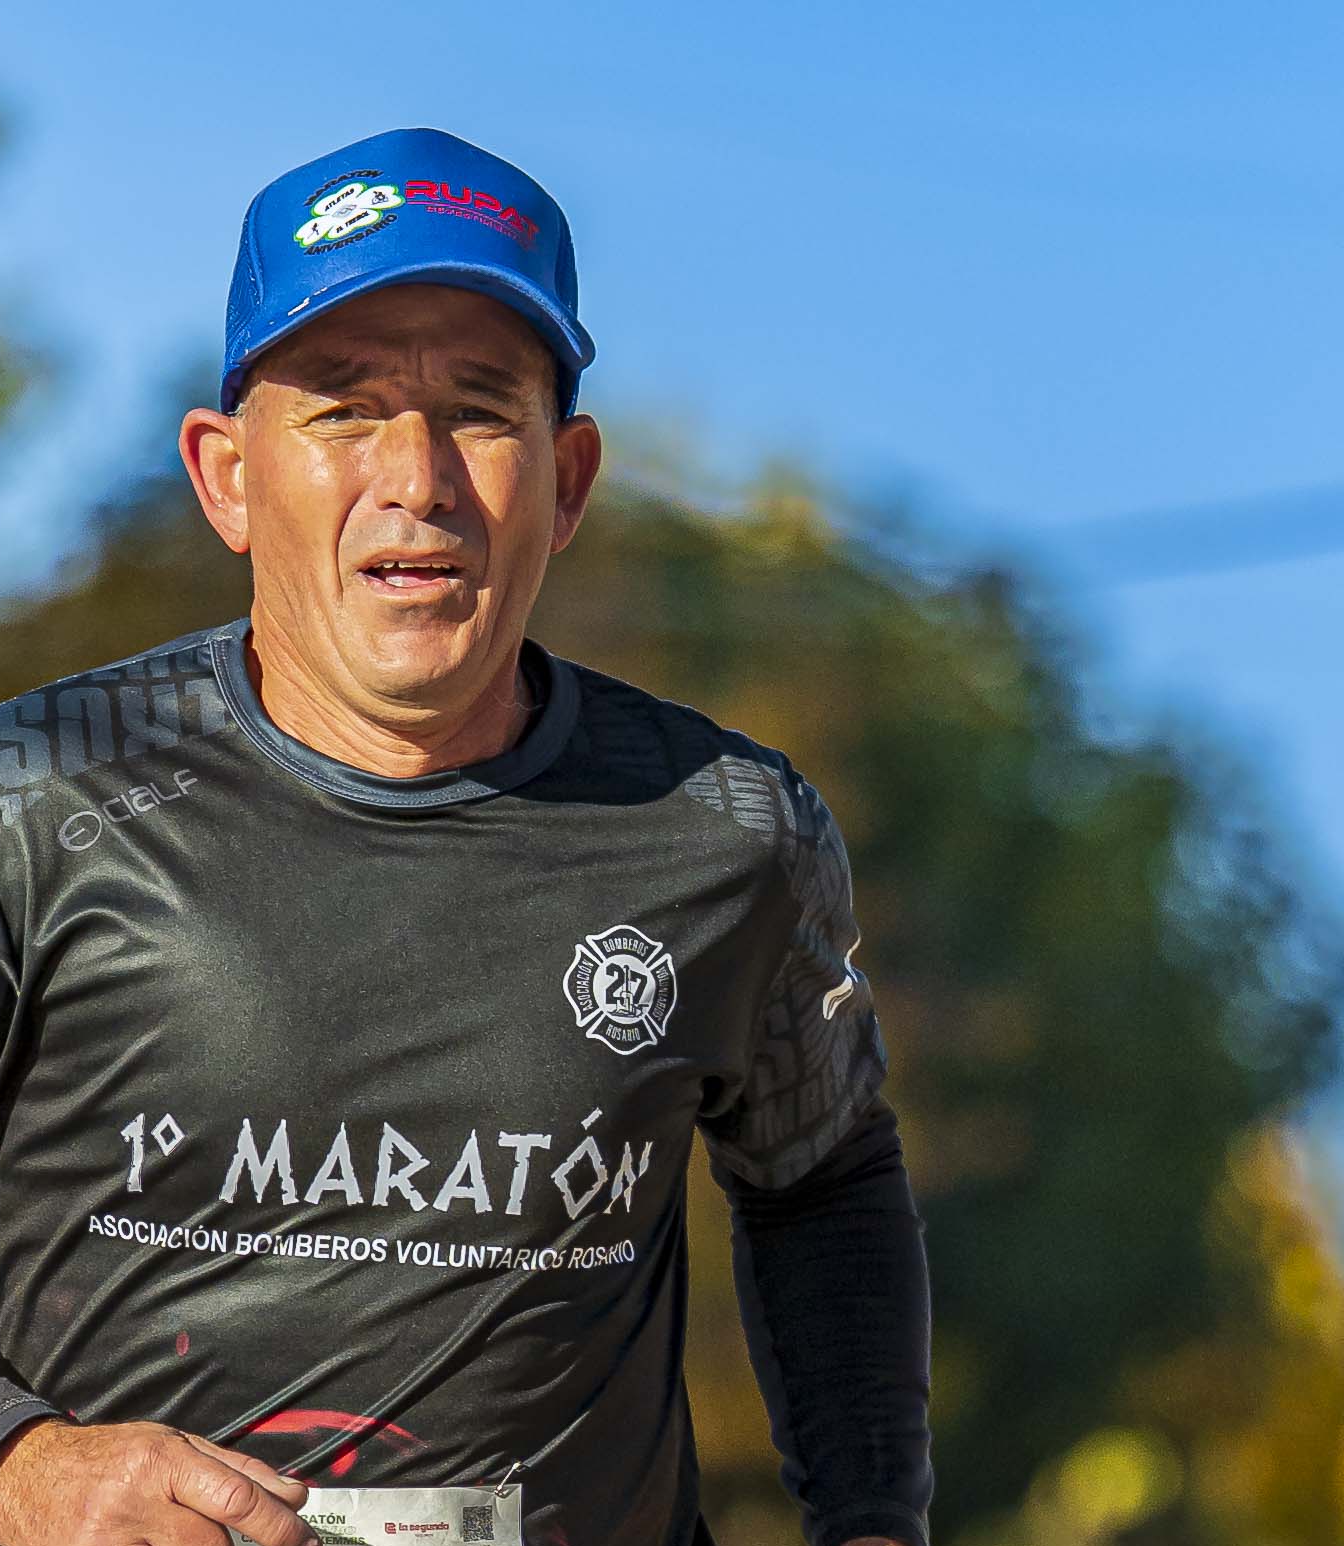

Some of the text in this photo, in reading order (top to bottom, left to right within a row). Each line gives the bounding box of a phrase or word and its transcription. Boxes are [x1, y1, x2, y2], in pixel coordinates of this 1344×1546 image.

[325, 188, 355, 212] ATLETAS
[602, 937, 650, 957] BOMBEROS
[576, 960, 594, 1012] ASOCIACIÓN
[605, 962, 649, 1006] 27
[605, 1023, 641, 1042] ROSARIO
[219, 1107, 653, 1221] MARATÓN
[88, 1215, 228, 1253] ASOCIACIÓN
[235, 1231, 388, 1263] BOMBEROS
[396, 1239, 566, 1271] VOLUNTARIOS
